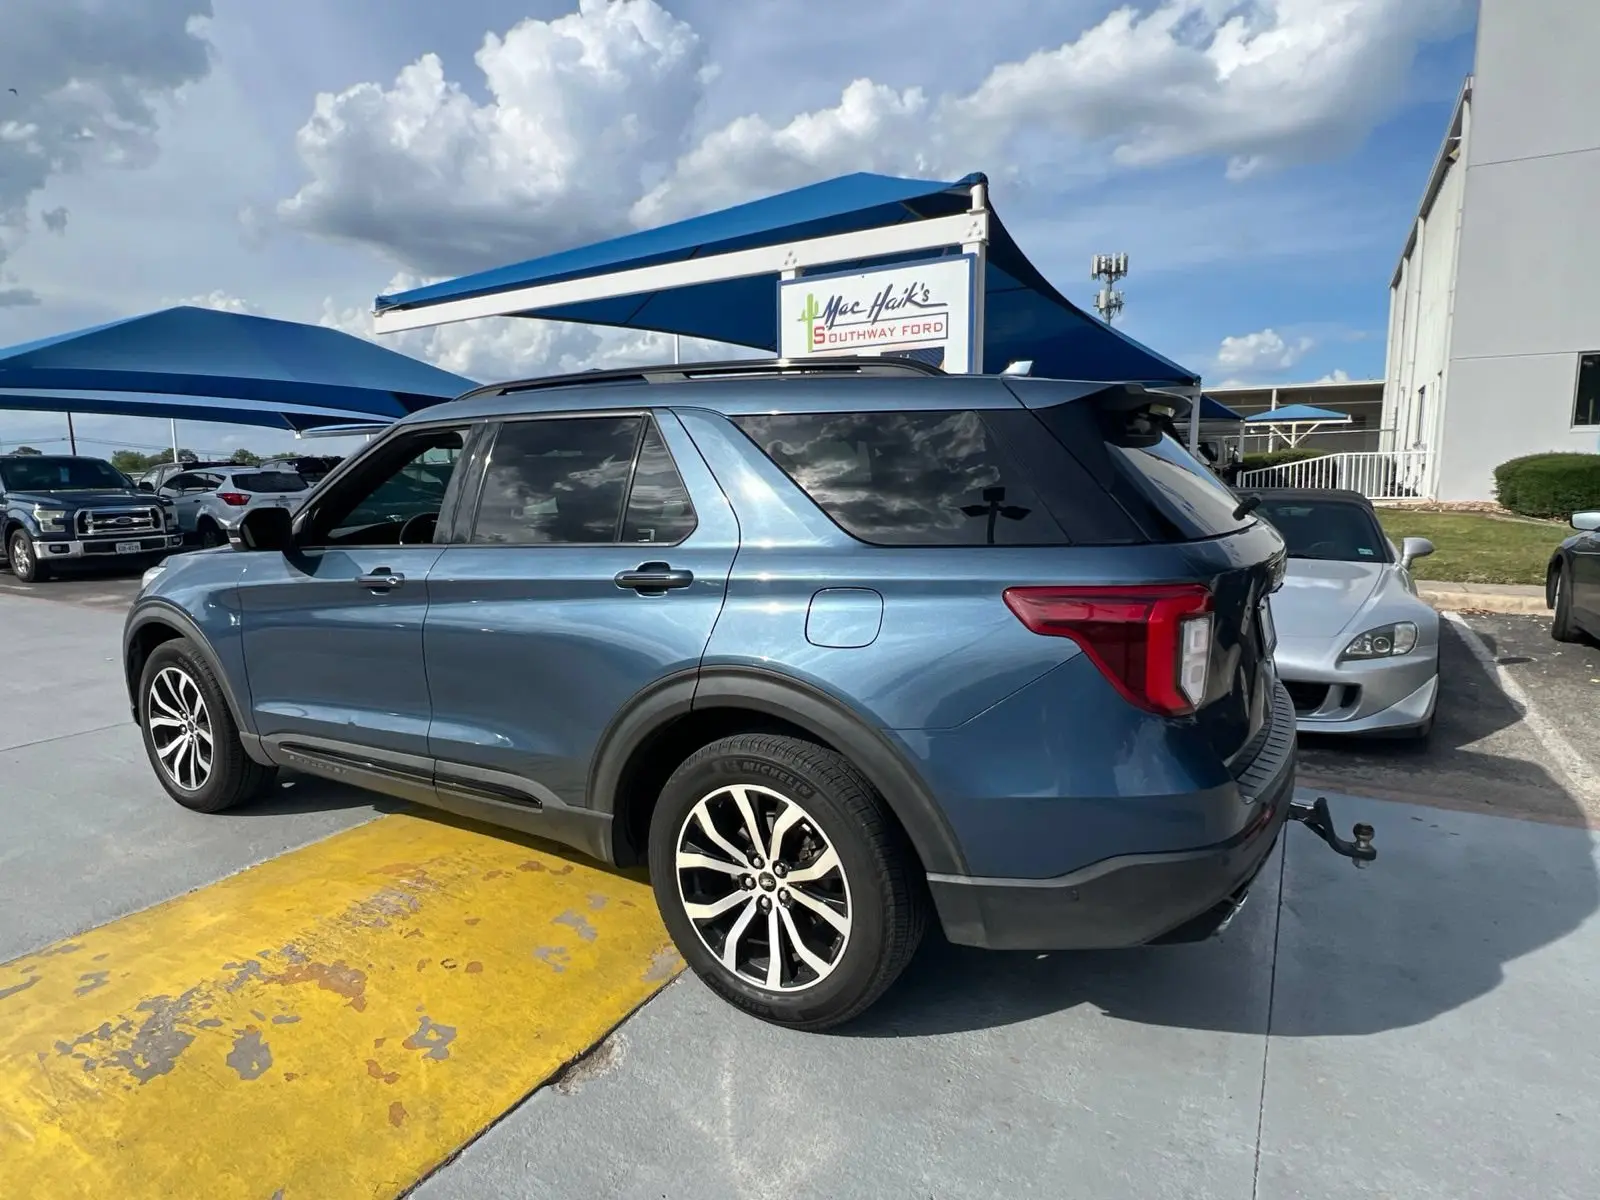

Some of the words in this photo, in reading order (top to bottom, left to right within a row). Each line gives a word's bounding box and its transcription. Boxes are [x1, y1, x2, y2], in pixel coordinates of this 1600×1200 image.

[822, 295, 867, 331] Mac
[867, 281, 948, 325] Haik's
[813, 325, 897, 344] SOUTHWAY
[902, 321, 943, 336] FORD
[742, 761, 813, 798] MICHELIN
